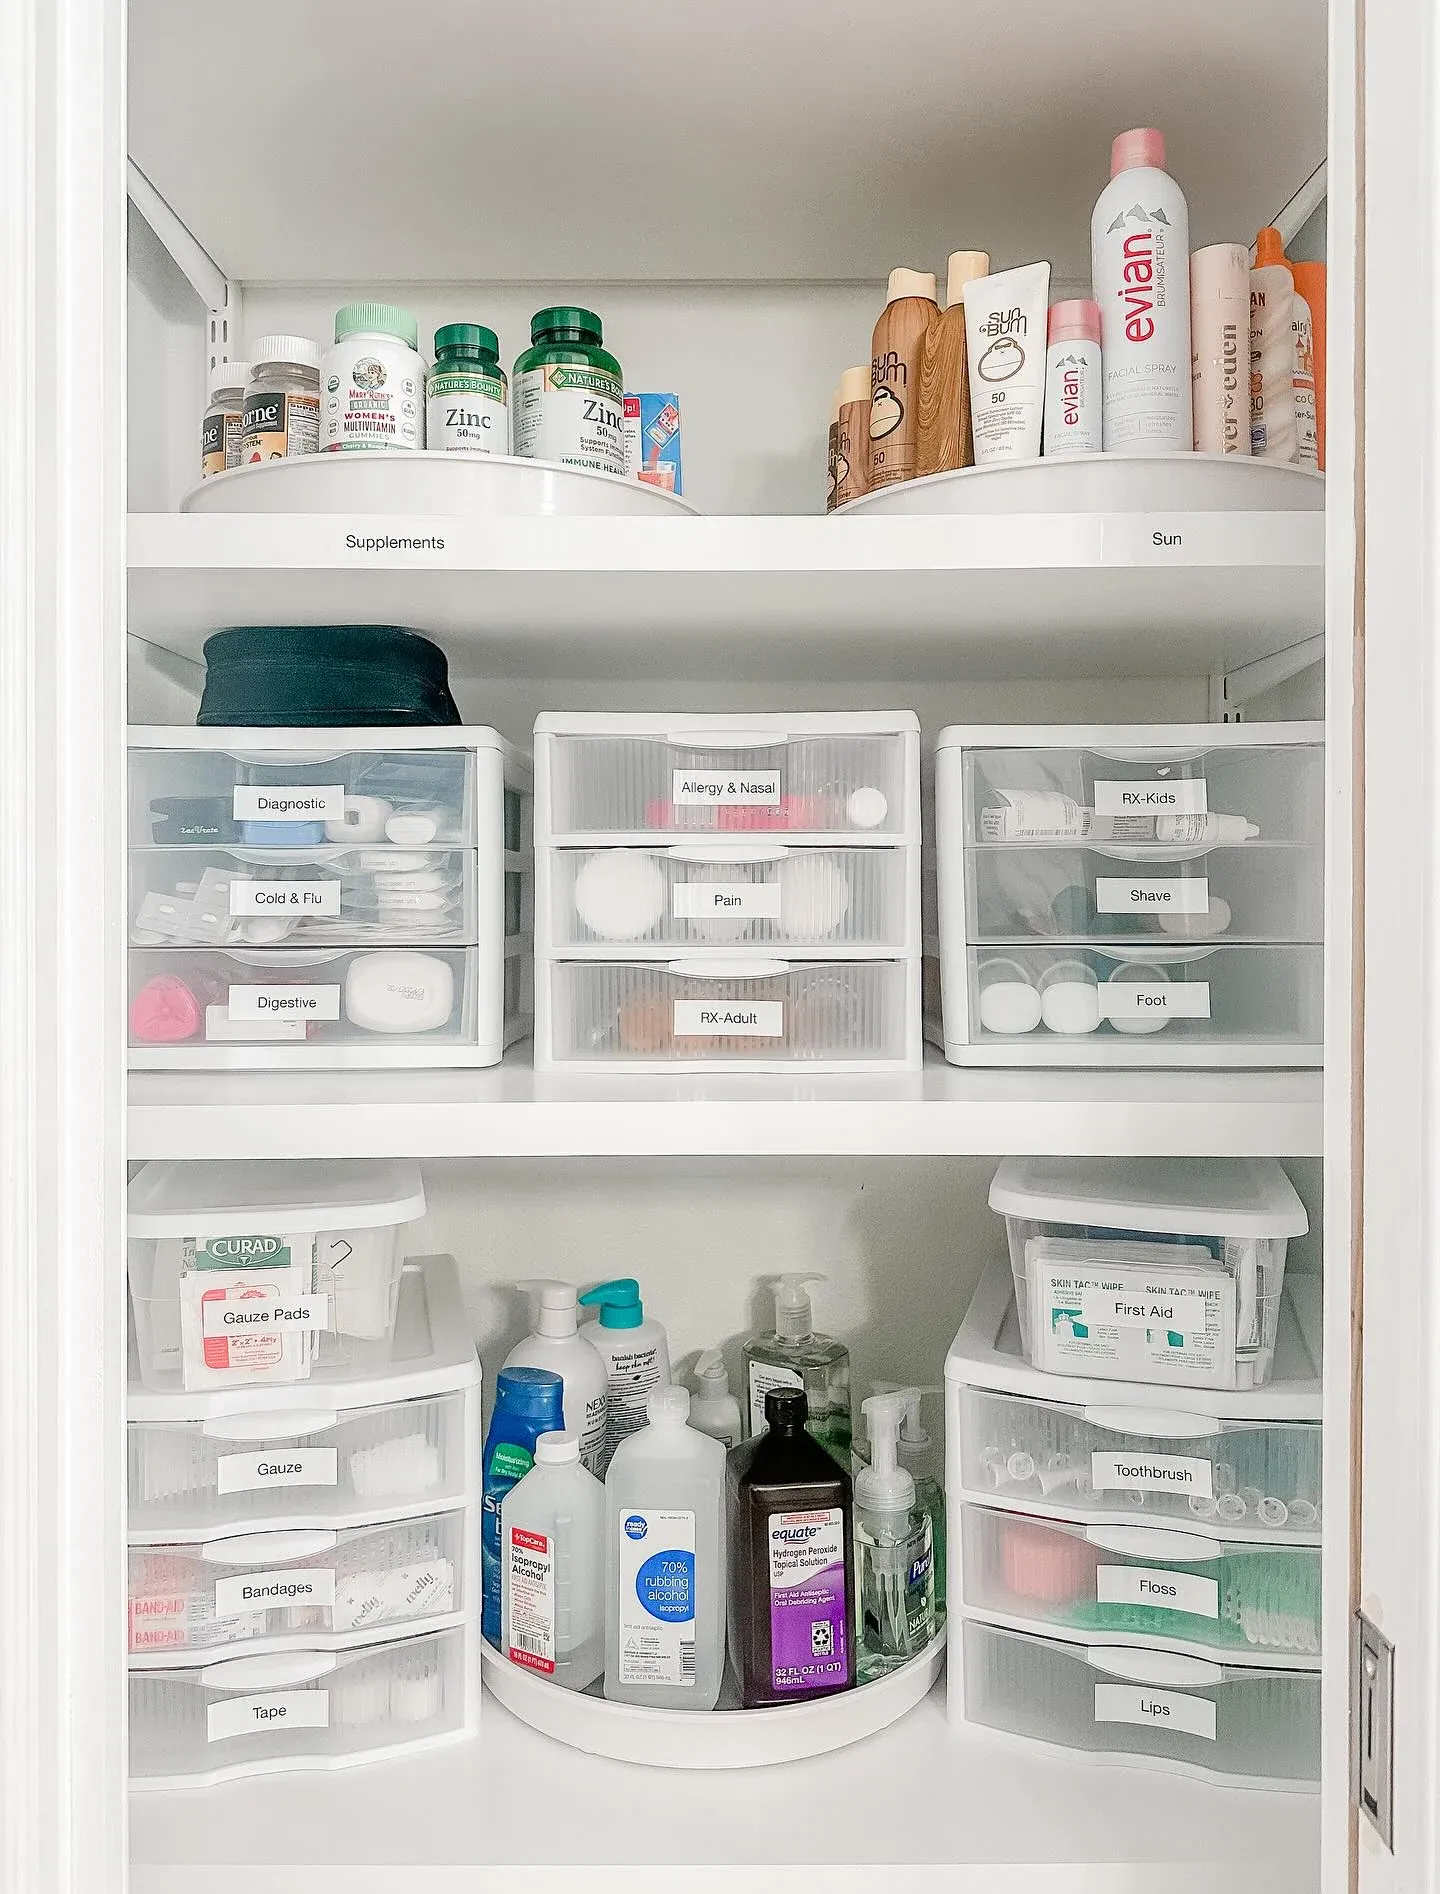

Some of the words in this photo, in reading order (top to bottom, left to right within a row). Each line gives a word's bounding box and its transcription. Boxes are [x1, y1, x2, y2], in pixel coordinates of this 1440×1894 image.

[1157, 234, 1166, 307] BRUMISATEUR
[1118, 233, 1155, 342] evian
[1108, 367, 1142, 381] FACIAL
[1144, 363, 1177, 375] SPRAY
[434, 380, 469, 392] NATURE'S
[471, 382, 501, 396] BOUNTY
[568, 373, 610, 390] NATURE'S
[353, 400, 386, 409] ORGANIC
[992, 392, 1006, 404] 50
[1061, 370, 1079, 425] evian
[344, 413, 396, 422] WOMEN'S
[446, 409, 491, 429] Zinc
[344, 421, 396, 434] MULTIVITAMIN
[456, 429, 468, 438] 50
[596, 426, 607, 438] 50
[349, 432, 390, 440] GUMMIES
[580, 437, 609, 448] Supports
[346, 535, 445, 551] Supplements
[1152, 532, 1182, 545] Sun
[682, 782, 724, 796] Allergy
[727, 782, 737, 793] &
[740, 782, 775, 793] Nasal
[257, 798, 326, 812] Diagnostic
[1122, 793, 1176, 805] RX-Kids
[255, 892, 285, 904] Cold
[290, 893, 300, 904] &
[303, 892, 322, 904] Flu
[714, 895, 742, 906] Pain
[1131, 889, 1171, 903] Shave
[257, 997, 317, 1011] Digestive
[1136, 993, 1167, 1006] Foot
[700, 1012, 758, 1024] RX-Adult
[212, 1238, 277, 1257] CURAD
[1050, 1279, 1072, 1288] SKIN
[1145, 1286, 1167, 1295] SKIN
[1198, 1290, 1221, 1300] WIPE
[223, 1312, 270, 1324] Gauze
[274, 1308, 311, 1320] Pads
[1115, 1303, 1146, 1316] First
[1150, 1305, 1173, 1319] Aid
[257, 1463, 303, 1475] Gauze
[1114, 1464, 1193, 1482] Toothbrush
[773, 1549, 807, 1560] Hydrogen
[808, 1544, 837, 1555] Peroxide
[511, 1553, 550, 1573] Isopropyl
[661, 1562, 688, 1573] 70%
[773, 1559, 799, 1570] Topical
[800, 1558, 828, 1567] Solution
[512, 1565, 544, 1581] Alcohol
[243, 1582, 313, 1599] Bandages
[645, 1577, 689, 1590] rubbing
[1139, 1580, 1177, 1597] Floss
[648, 1589, 689, 1601] alcohol
[800, 1588, 830, 1597] Antiseptic
[818, 1595, 836, 1604] Agent
[659, 1605, 690, 1613] isopropyl
[775, 1668, 787, 1677] 32
[788, 1667, 800, 1676] FL
[801, 1666, 815, 1675] OZ
[816, 1665, 824, 1674] (1
[826, 1662, 841, 1672] QT)
[775, 1676, 806, 1685] 946mL
[252, 1706, 287, 1720] Tape
[1141, 1700, 1171, 1717] Lips
